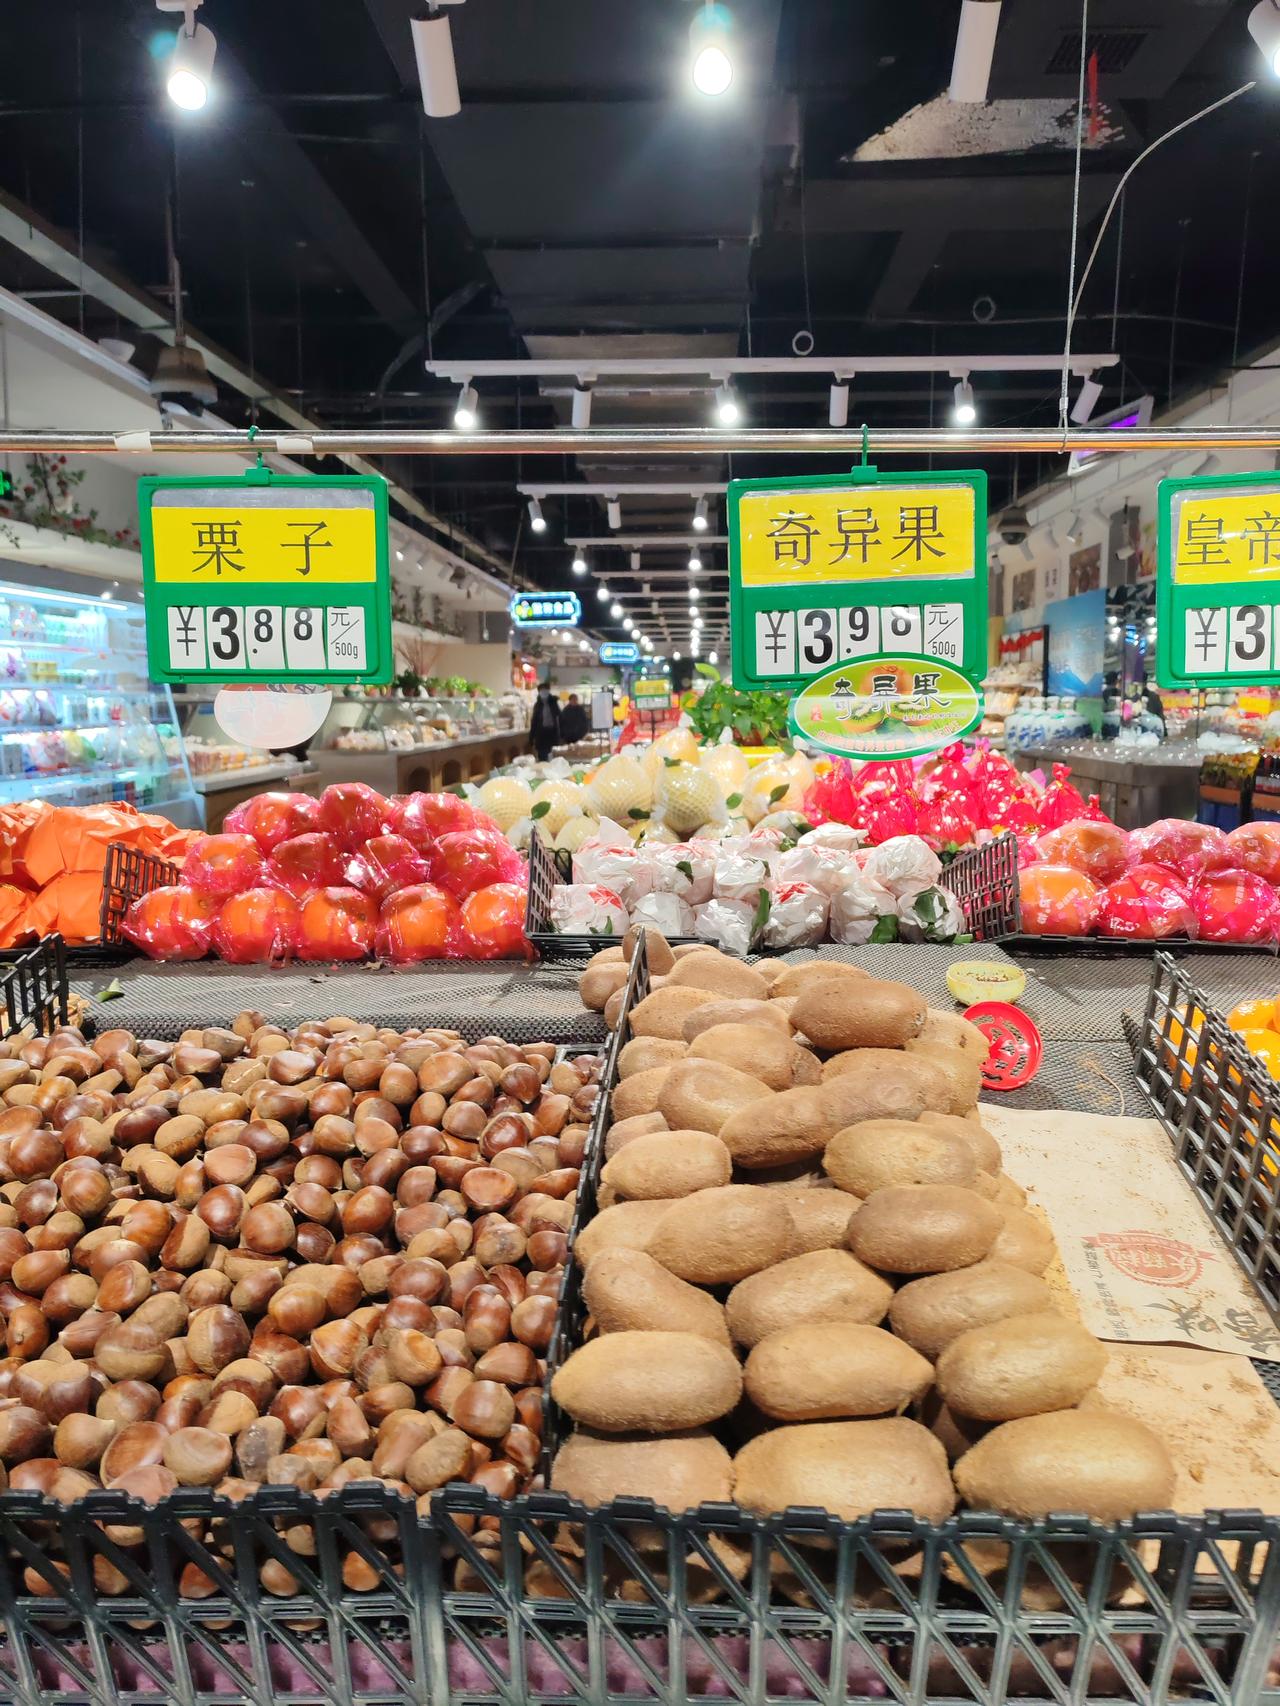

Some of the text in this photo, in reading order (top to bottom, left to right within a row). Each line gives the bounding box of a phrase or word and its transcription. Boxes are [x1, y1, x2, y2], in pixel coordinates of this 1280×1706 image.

[191, 520, 334, 576] 栗子
[765, 504, 947, 566] 奇异果
[829, 672, 951, 721] 奇异果
